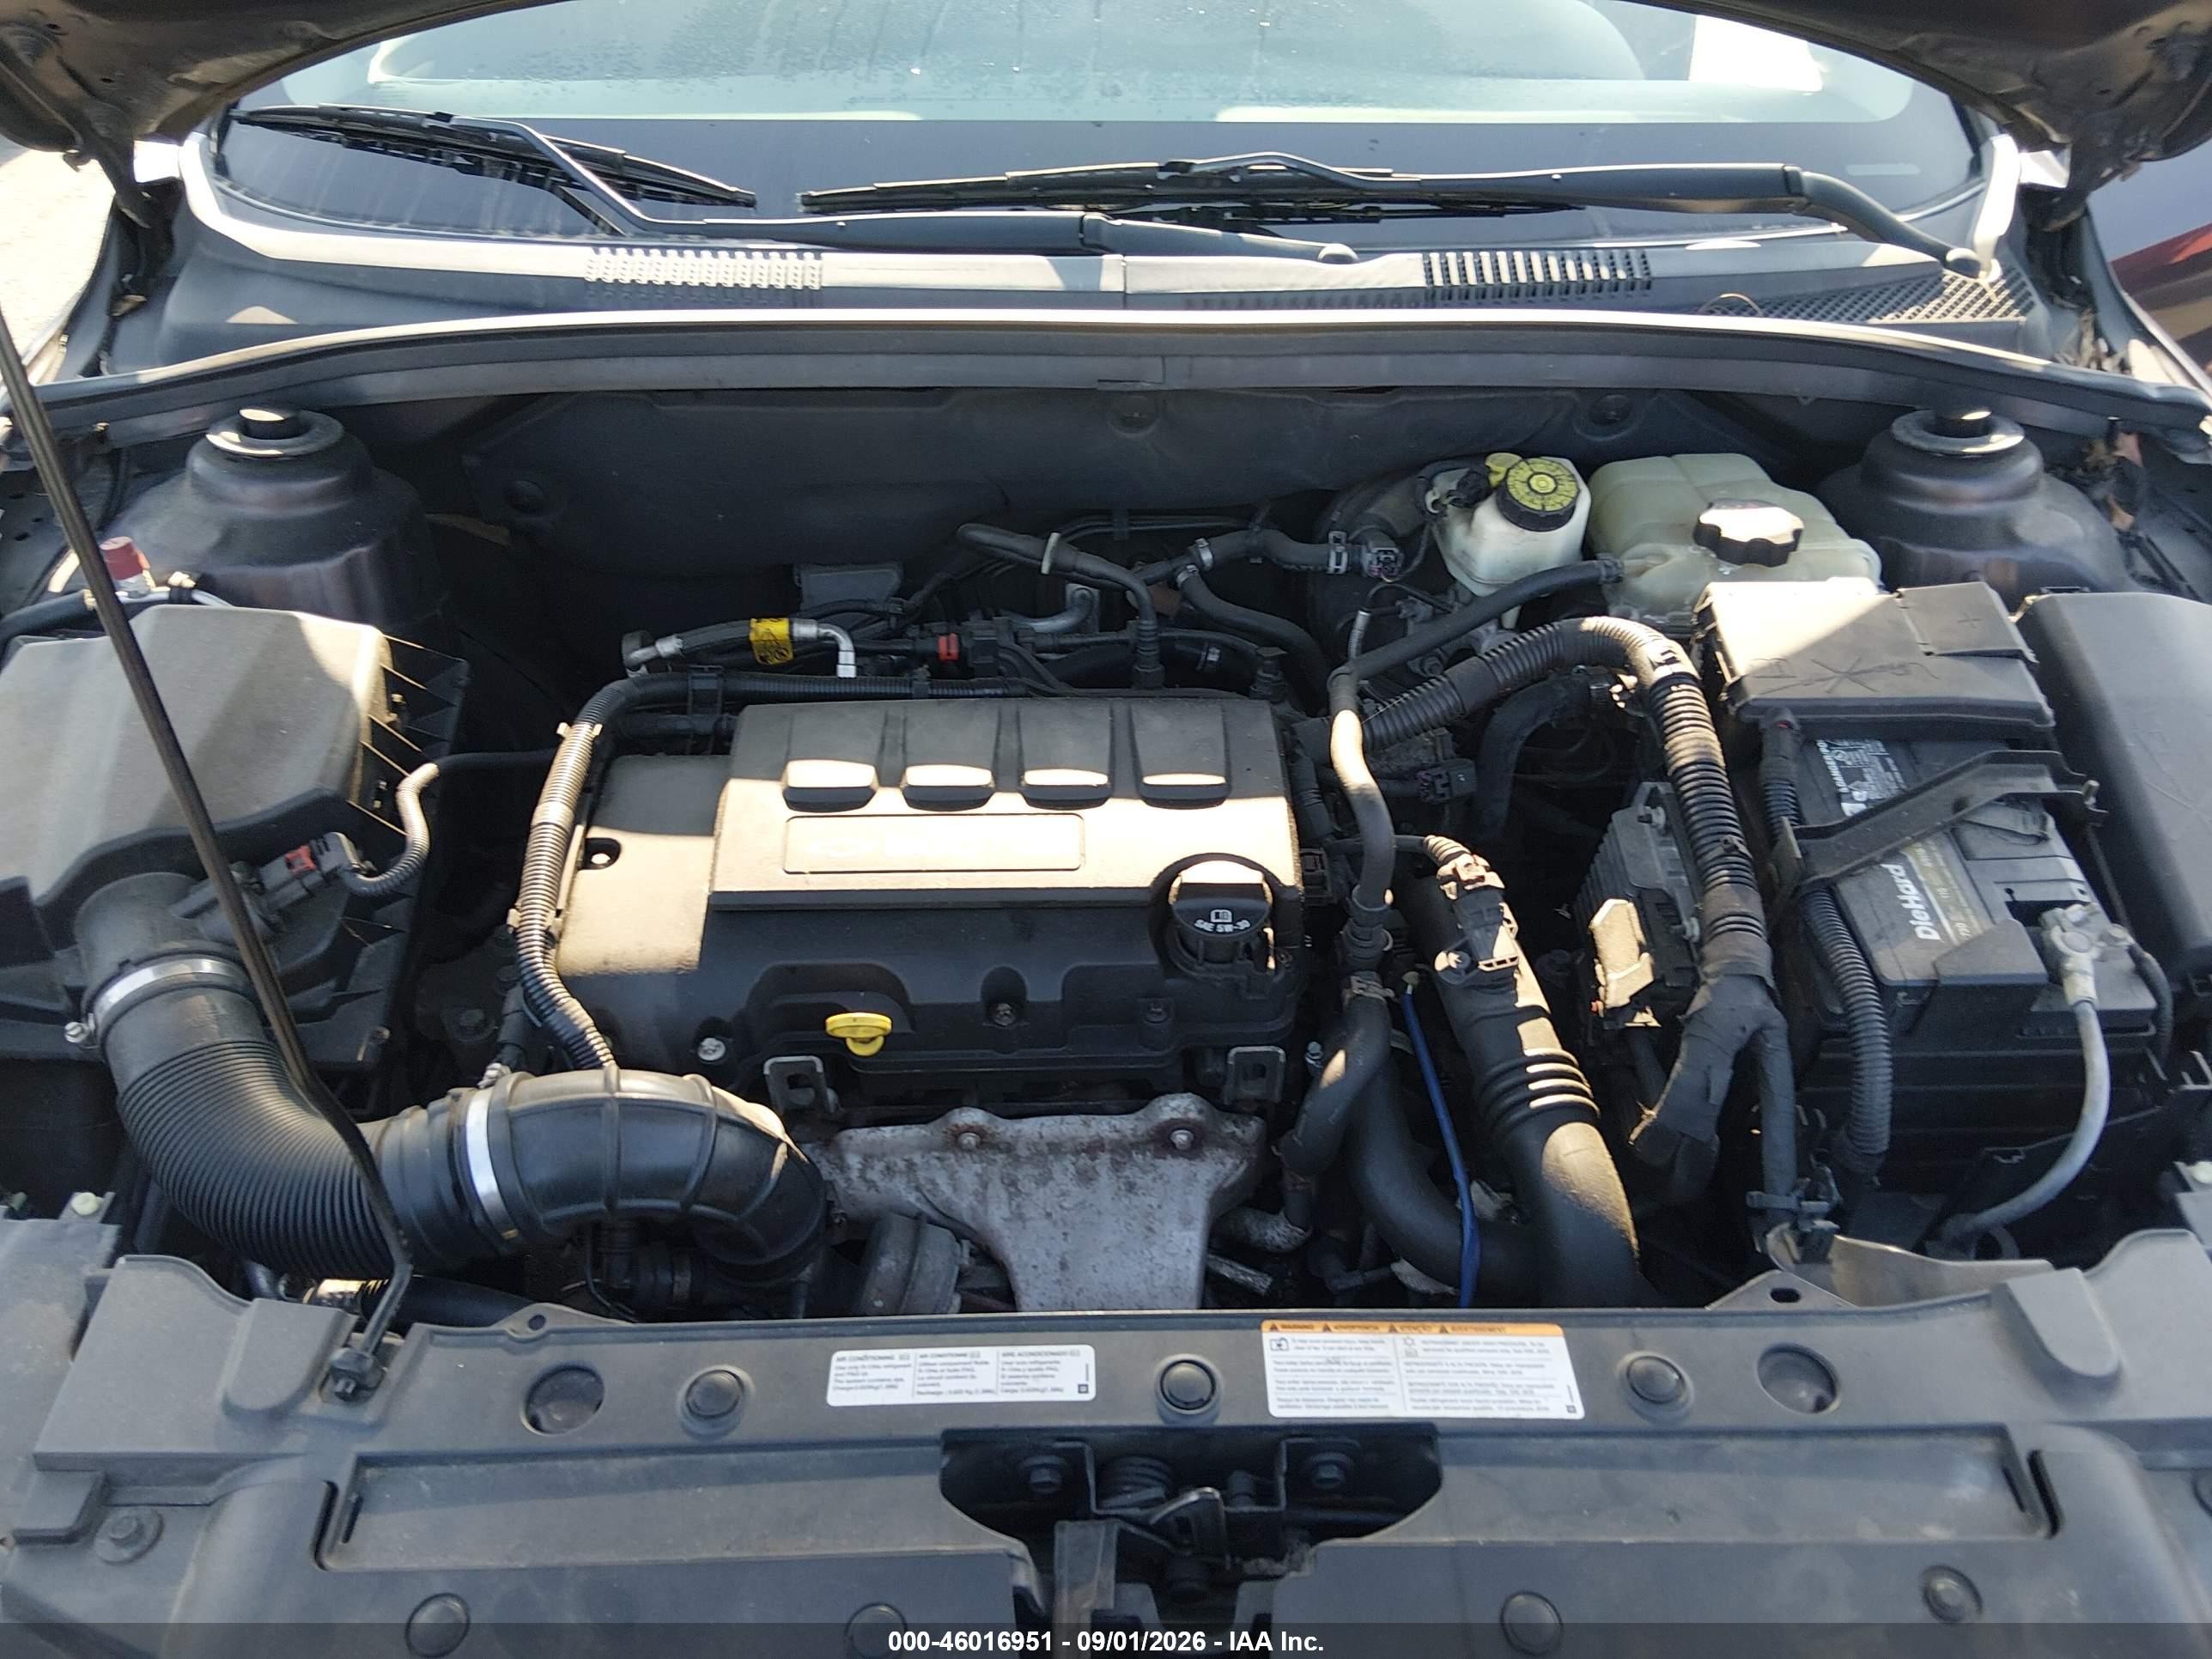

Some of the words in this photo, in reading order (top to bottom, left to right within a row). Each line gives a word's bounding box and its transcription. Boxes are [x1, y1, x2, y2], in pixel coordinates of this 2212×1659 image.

[1880, 863, 1943, 940] DieHard
[1194, 919, 1215, 932] SAE
[1216, 920, 1251, 933] 5W-30
